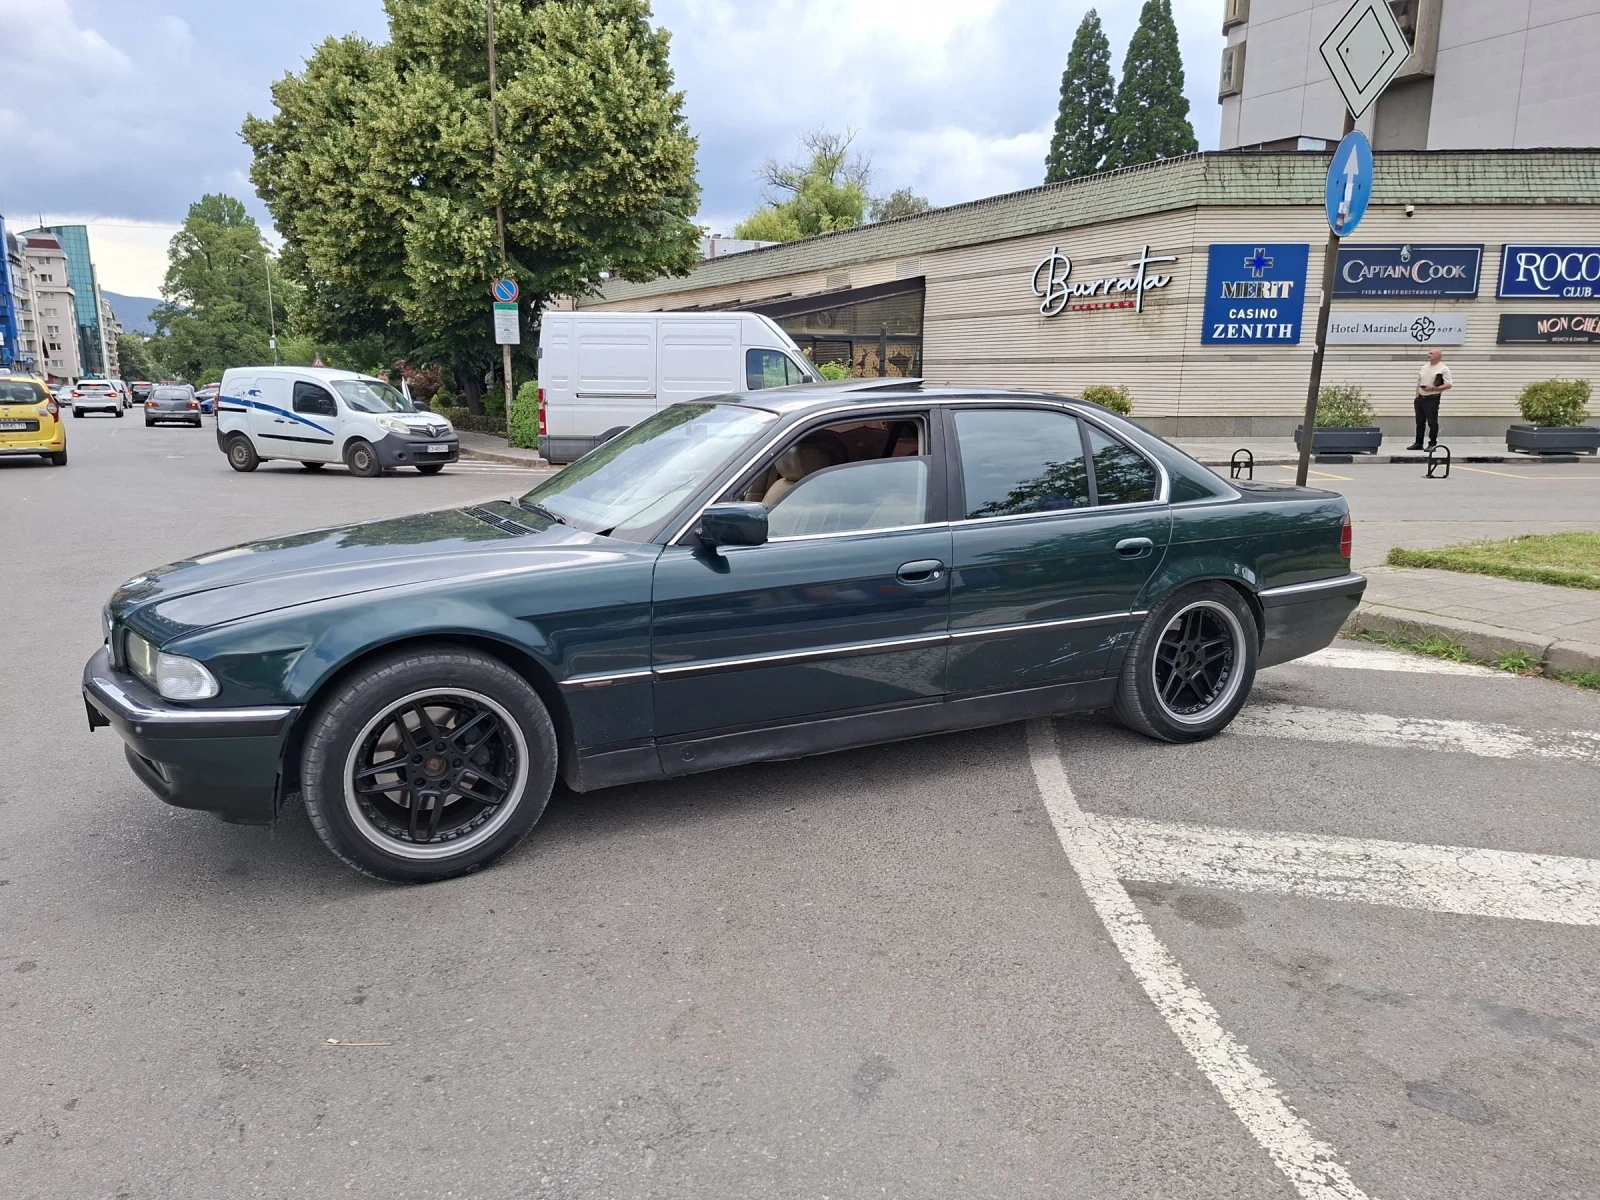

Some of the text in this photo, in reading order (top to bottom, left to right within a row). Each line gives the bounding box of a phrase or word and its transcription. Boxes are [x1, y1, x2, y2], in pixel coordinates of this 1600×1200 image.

[1342, 259, 1467, 283] CAPTAIN COOK
[1031, 245, 1179, 317] Burrata
[1220, 281, 1294, 299] MERIT
[1562, 286, 1592, 297] CLUB
[1229, 308, 1278, 319] CASINO
[1212, 323, 1294, 339] ZENITH
[1330, 322, 1360, 333] Hotel
[1362, 322, 1408, 333] Marinela
[1537, 316, 1569, 335] MON
